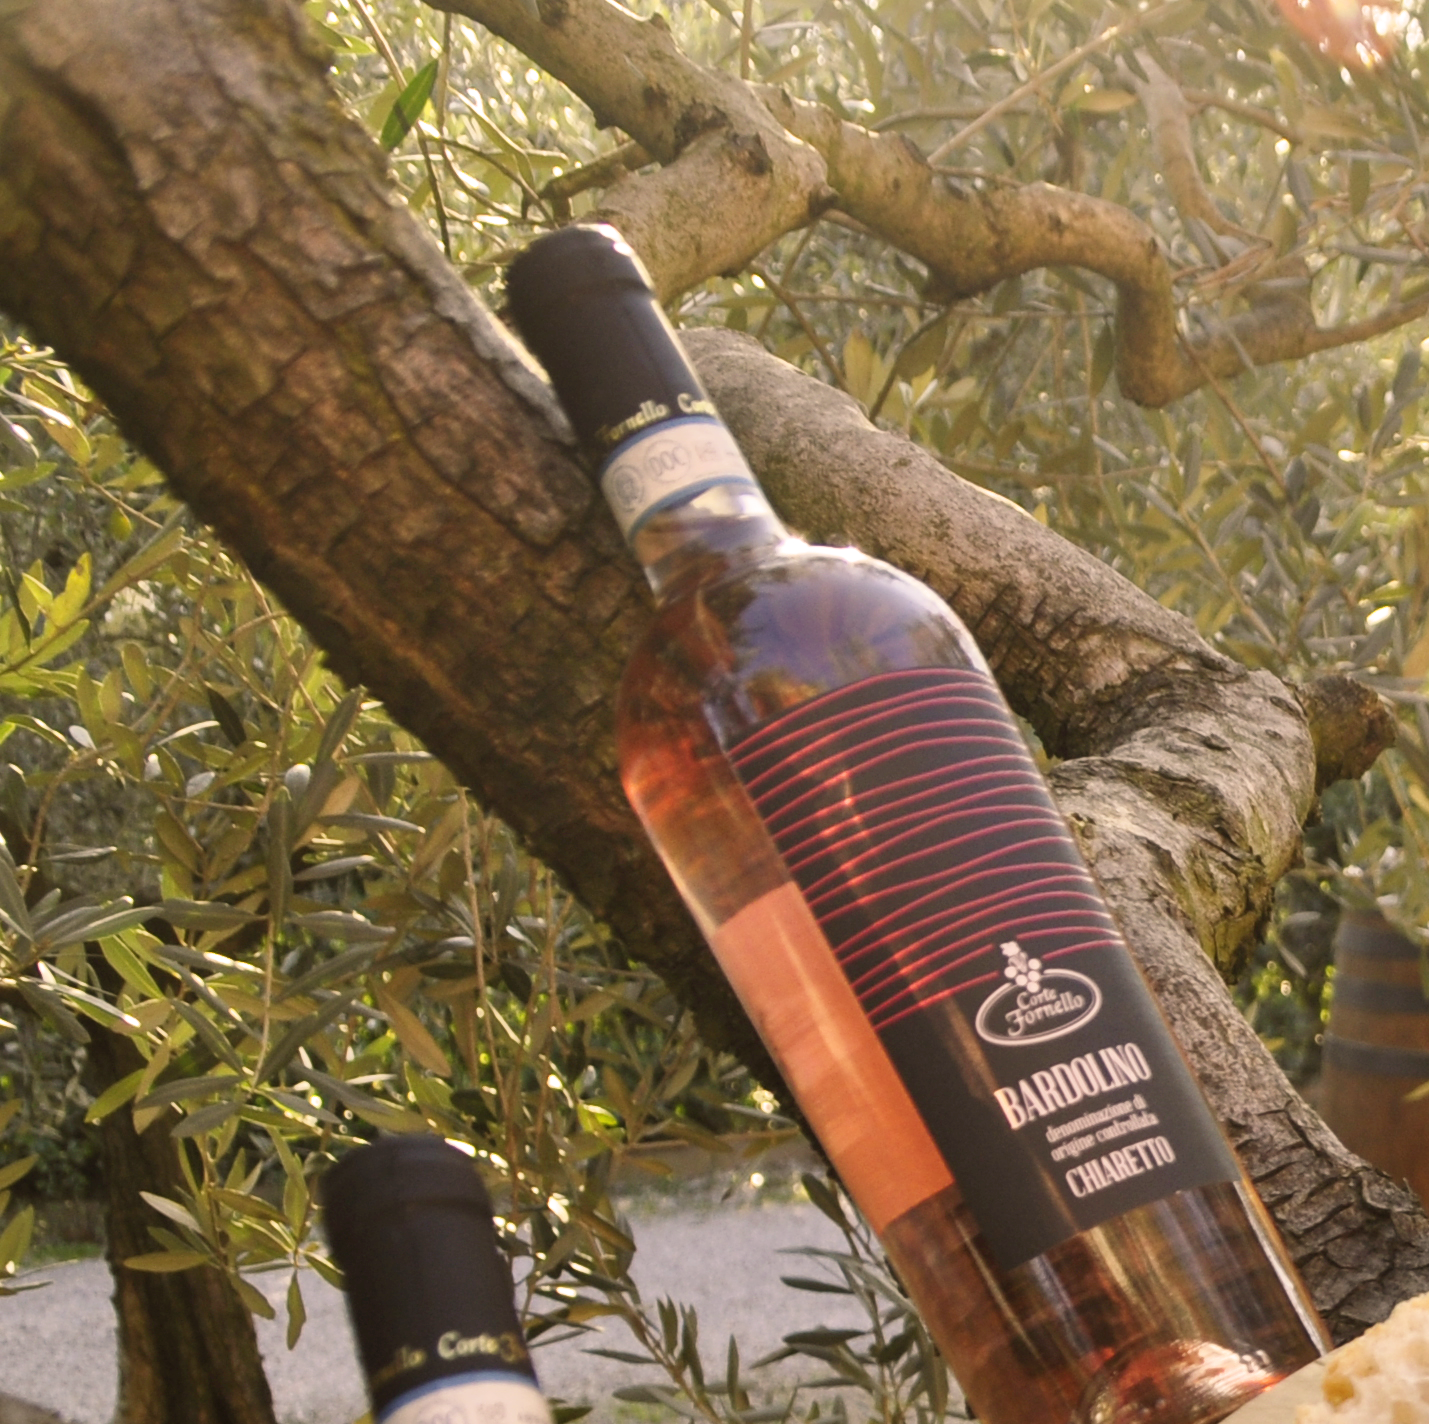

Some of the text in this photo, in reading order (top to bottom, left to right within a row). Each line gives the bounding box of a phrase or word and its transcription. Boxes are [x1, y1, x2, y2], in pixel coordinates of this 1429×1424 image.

[1005, 990, 1085, 1036] Fornello
[1016, 987, 1057, 1010] Corte
[994, 1042, 1152, 1130] BARDOLINO
[1046, 1093, 1147, 1143] denominazione di
[1051, 1111, 1159, 1162] origine controllata
[1065, 1135, 1177, 1198] CHIARETTO
